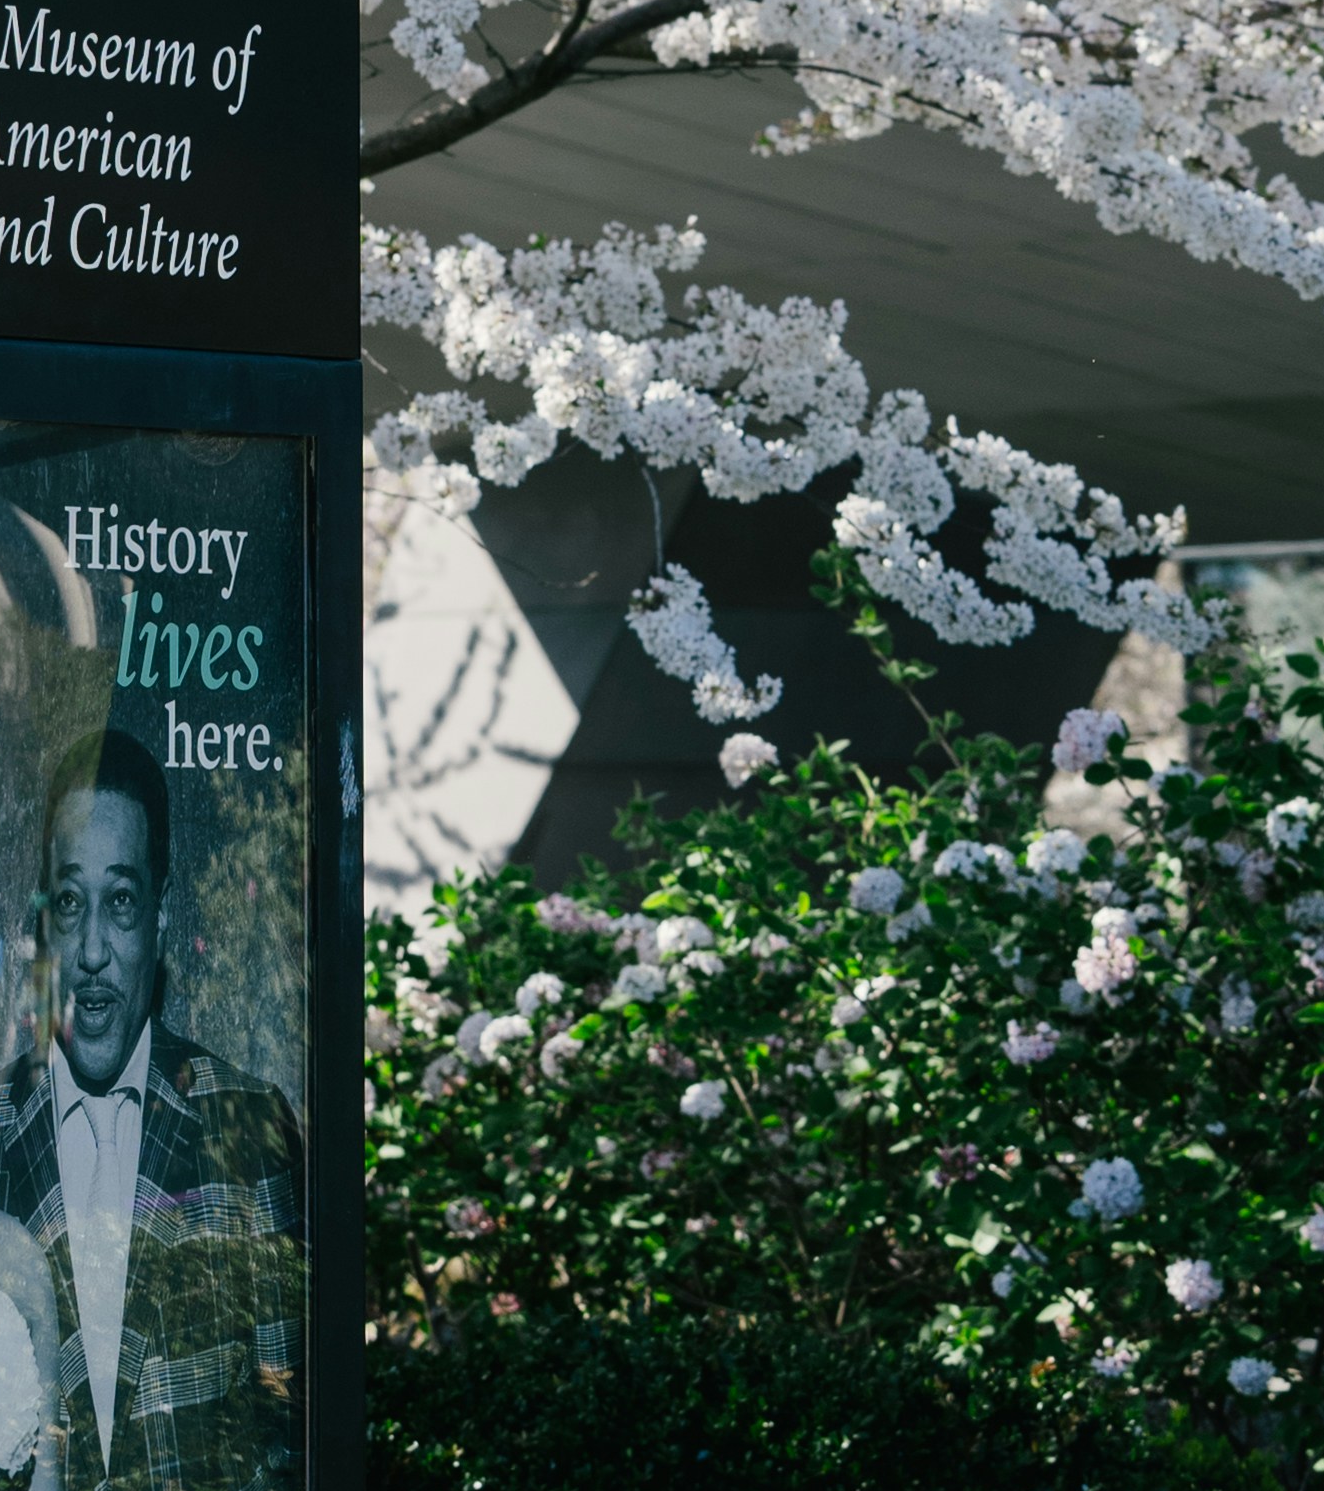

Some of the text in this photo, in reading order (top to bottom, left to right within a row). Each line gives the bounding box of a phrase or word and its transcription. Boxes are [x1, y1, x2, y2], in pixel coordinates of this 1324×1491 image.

[212, 25, 261, 114] of
[70, 203, 239, 281] Culture
[64, 503, 248, 599] History
[116, 590, 263, 691] lives
[164, 700, 283, 771] here.
